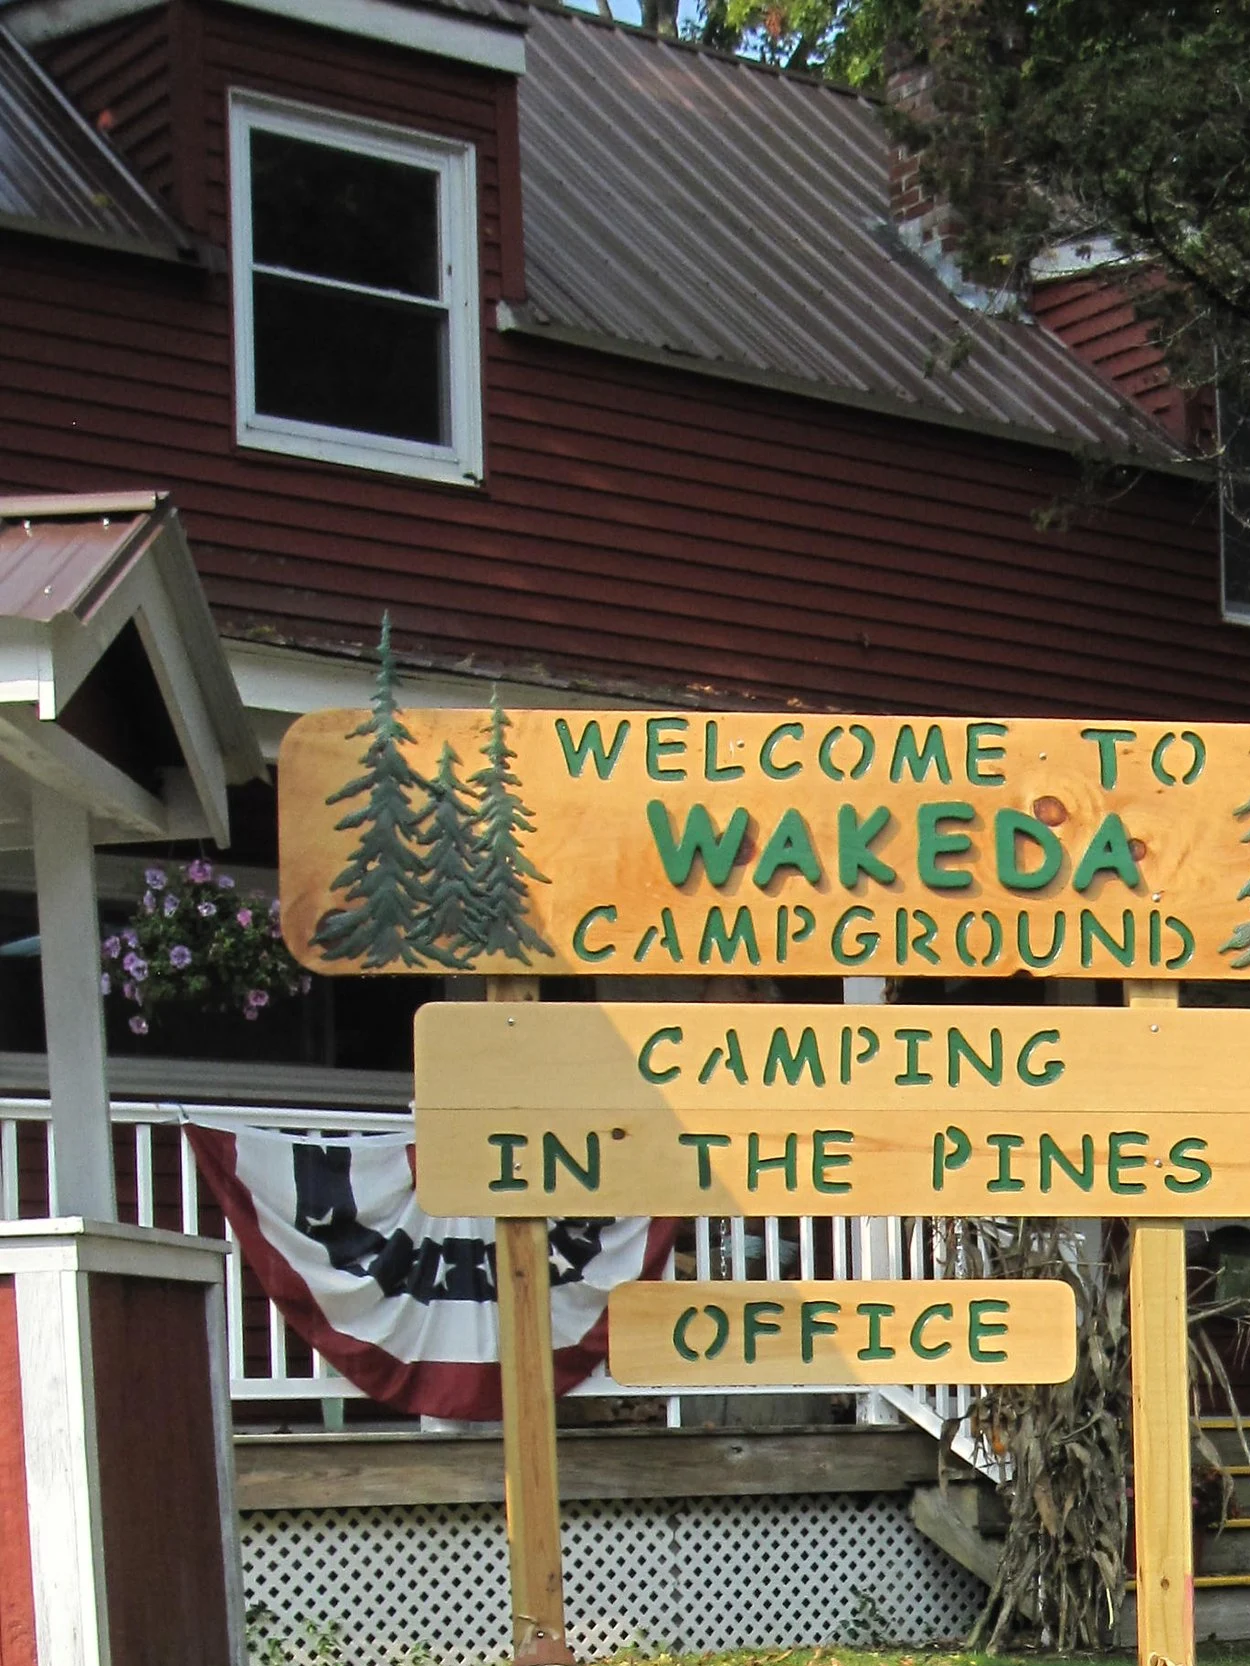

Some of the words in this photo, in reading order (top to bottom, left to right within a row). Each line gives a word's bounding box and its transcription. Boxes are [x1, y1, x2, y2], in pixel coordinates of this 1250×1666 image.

[556, 717, 1010, 787] WELCOME
[1080, 727, 1207, 791] TO
[646, 799, 1142, 893] WAKEDA
[572, 904, 1196, 971] CAMPGROUND
[637, 1025, 1067, 1088] CAMPING
[487, 1131, 602, 1194] IN
[677, 1129, 855, 1195] THE
[932, 1125, 1214, 1195] PINES
[672, 1299, 1010, 1366] OFFICE
